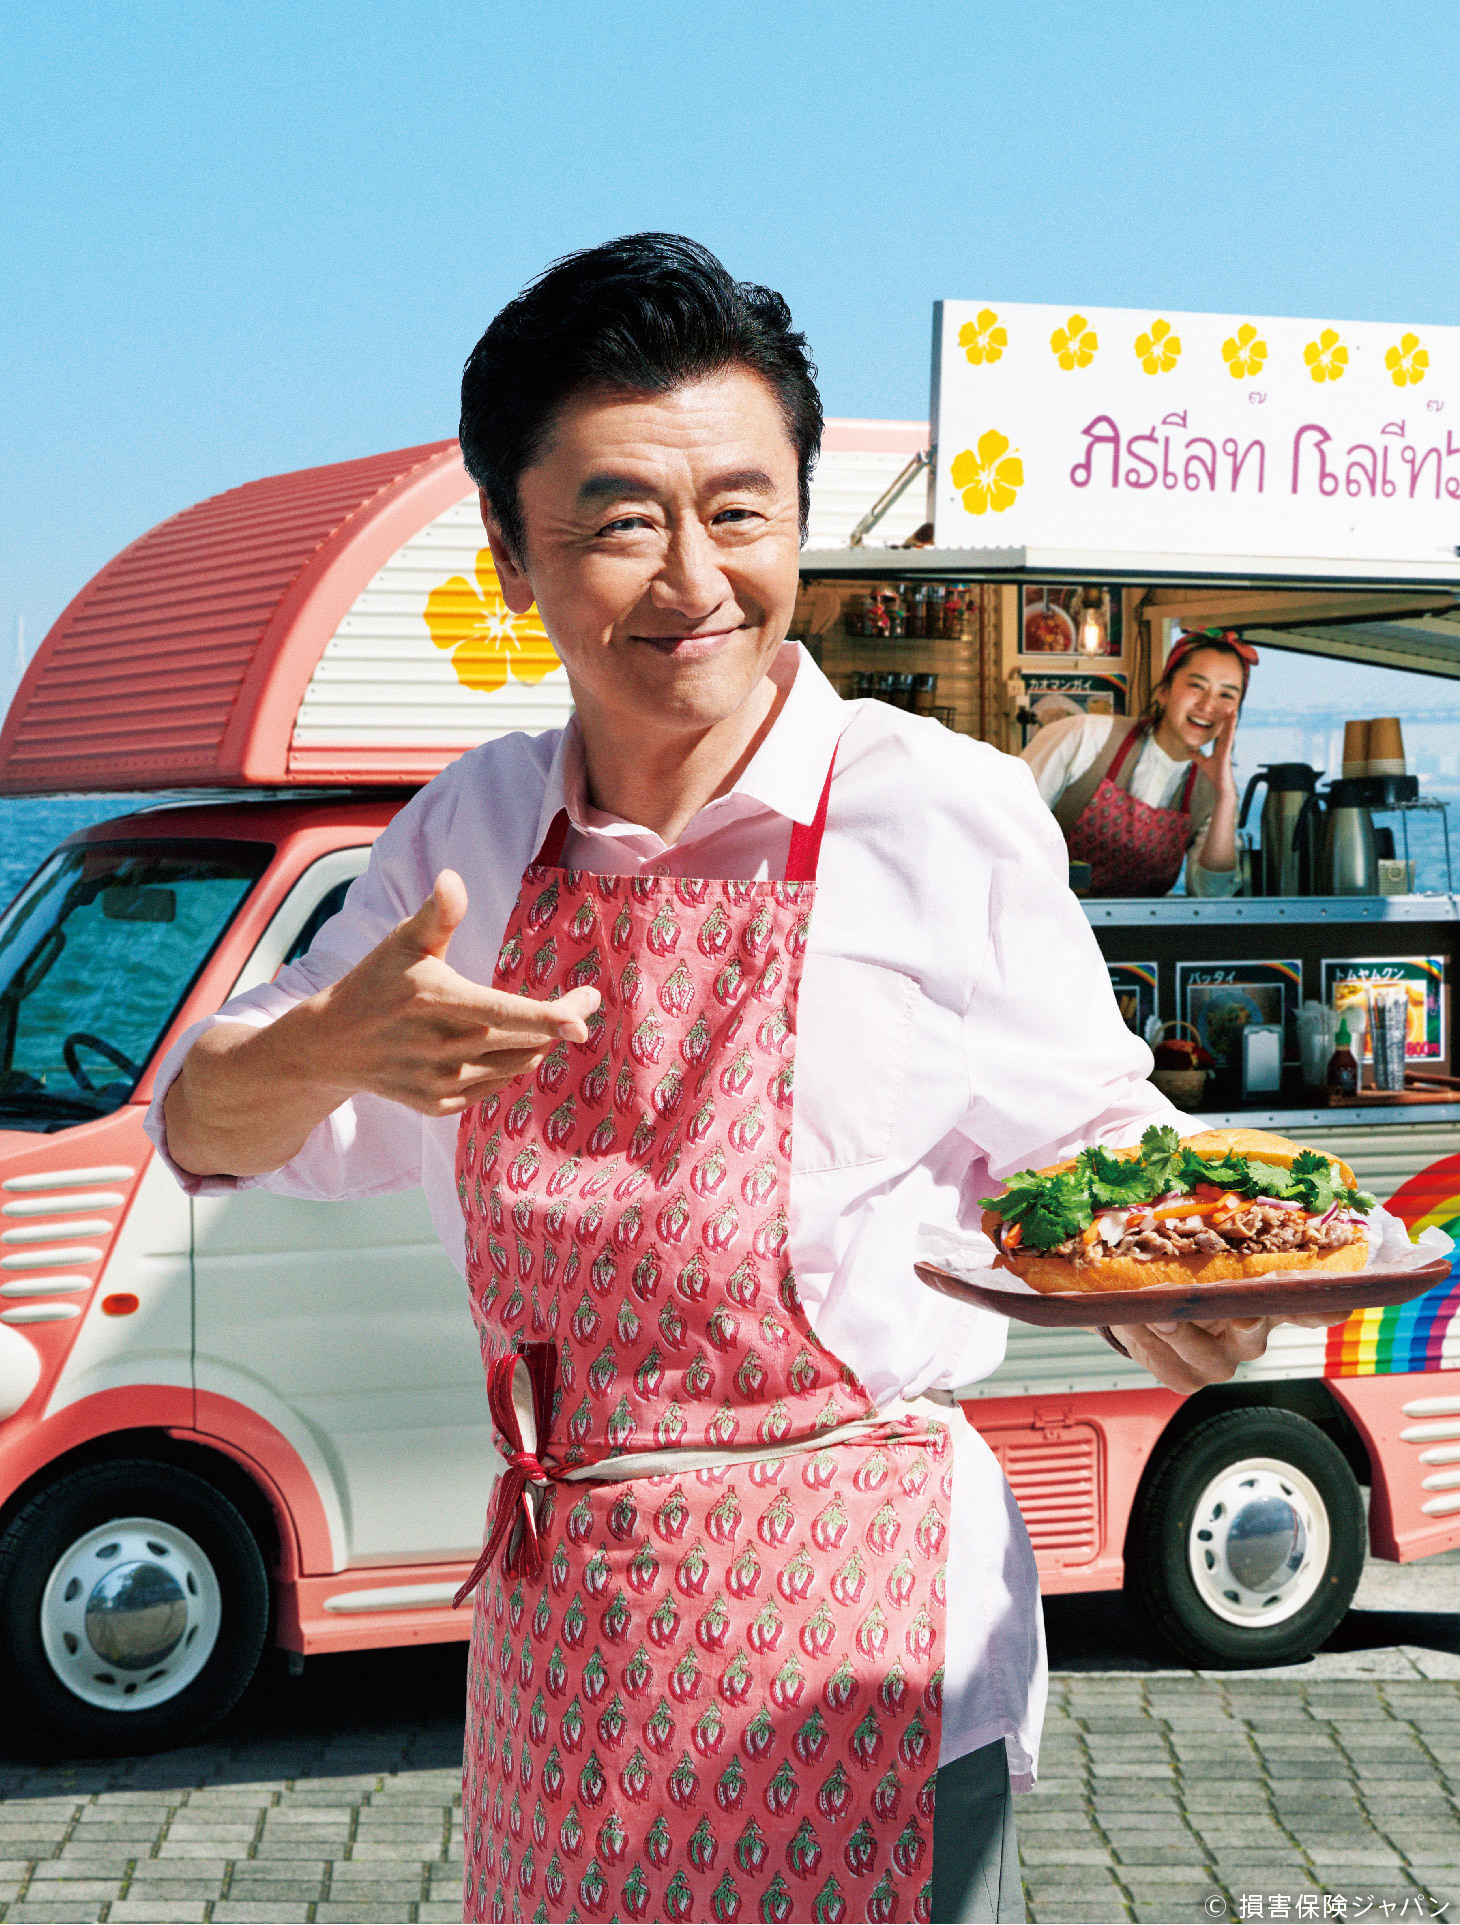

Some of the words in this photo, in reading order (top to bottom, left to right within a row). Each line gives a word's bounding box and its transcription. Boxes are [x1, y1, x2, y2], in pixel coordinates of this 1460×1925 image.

[1030, 679, 1092, 692] カオマンガイ
[1188, 970, 1237, 985] パッタイ
[1335, 967, 1405, 983] トムヤムクン
